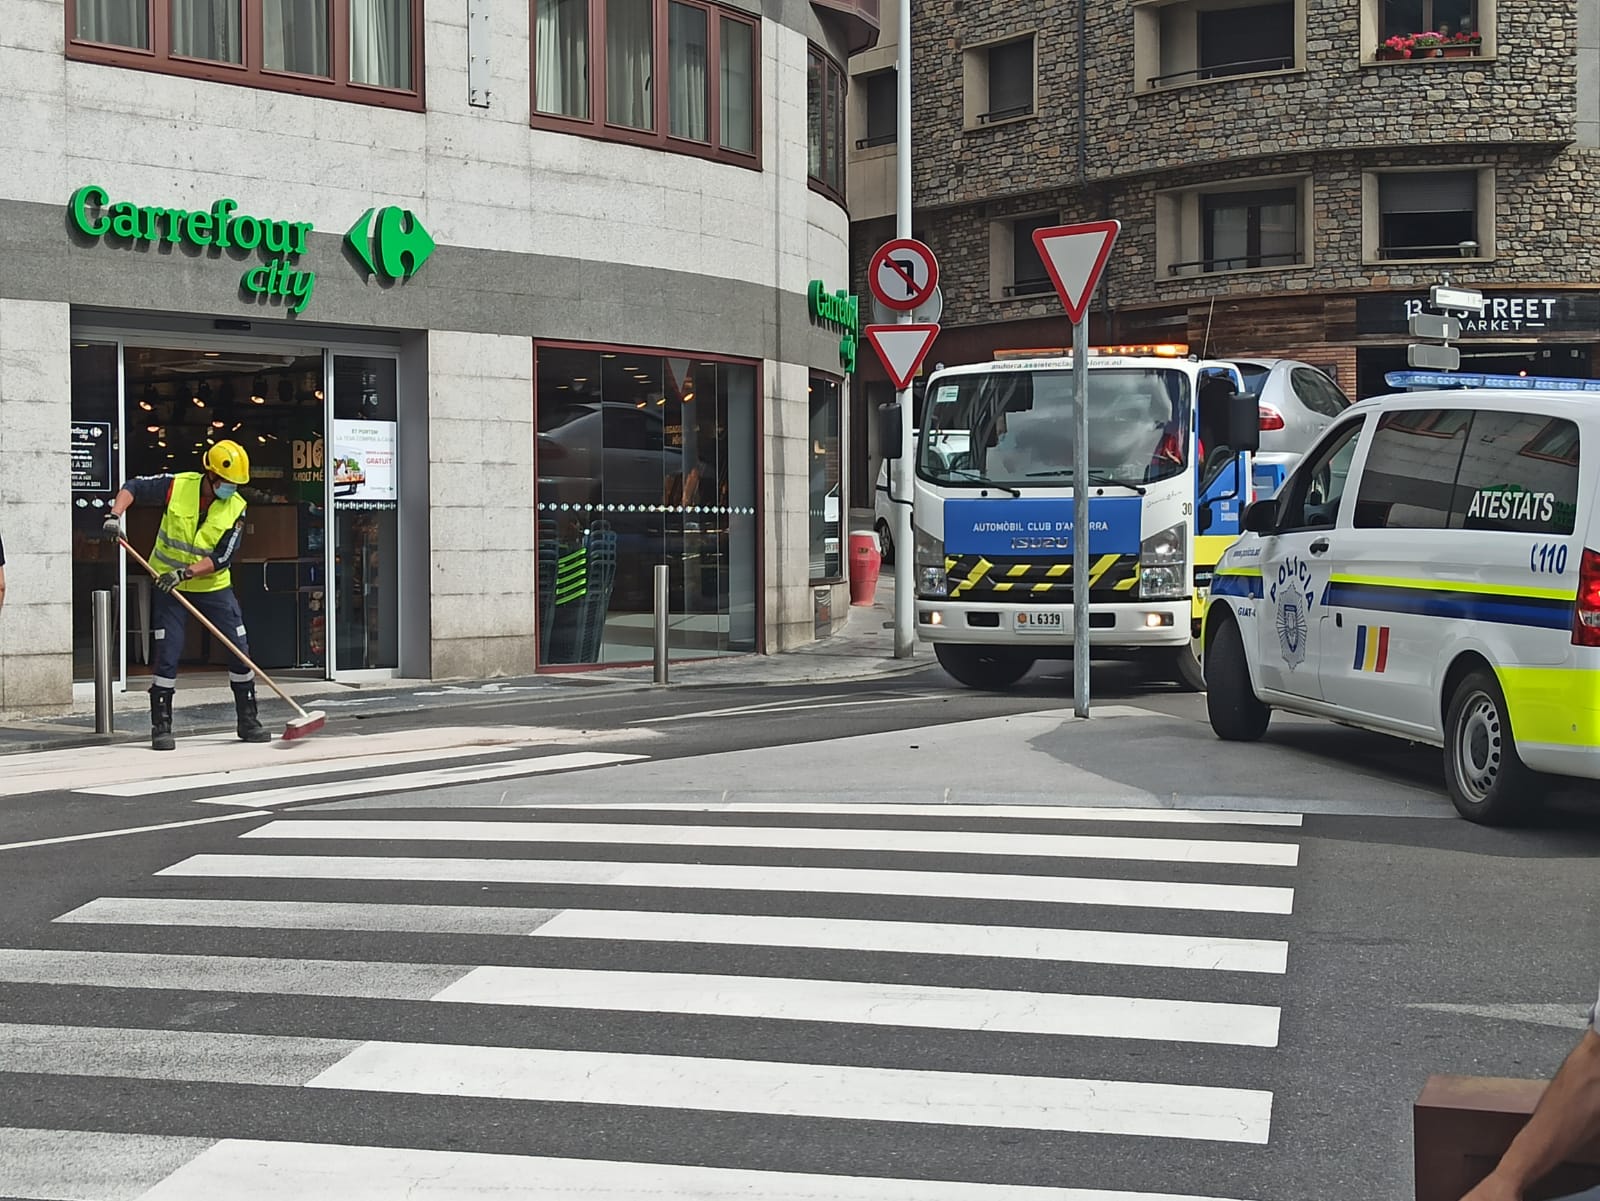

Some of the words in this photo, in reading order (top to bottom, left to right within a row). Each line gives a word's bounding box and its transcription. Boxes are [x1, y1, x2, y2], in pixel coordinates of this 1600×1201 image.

[70, 185, 313, 254] Carrefour
[245, 259, 315, 313] city
[1182, 502, 1192, 515] 30
[1468, 490, 1555, 521] ATESTATS
[973, 521, 1024, 532] AUTOMÒBIL
[1027, 522, 1051, 531] CLUB
[1055, 521, 1109, 531] D'ARRA
[1011, 536, 1068, 549] ISUZU
[1540, 543, 1568, 574] 110
[1270, 556, 1314, 613] POLICIA
[1037, 613, 1060, 625] 6339
